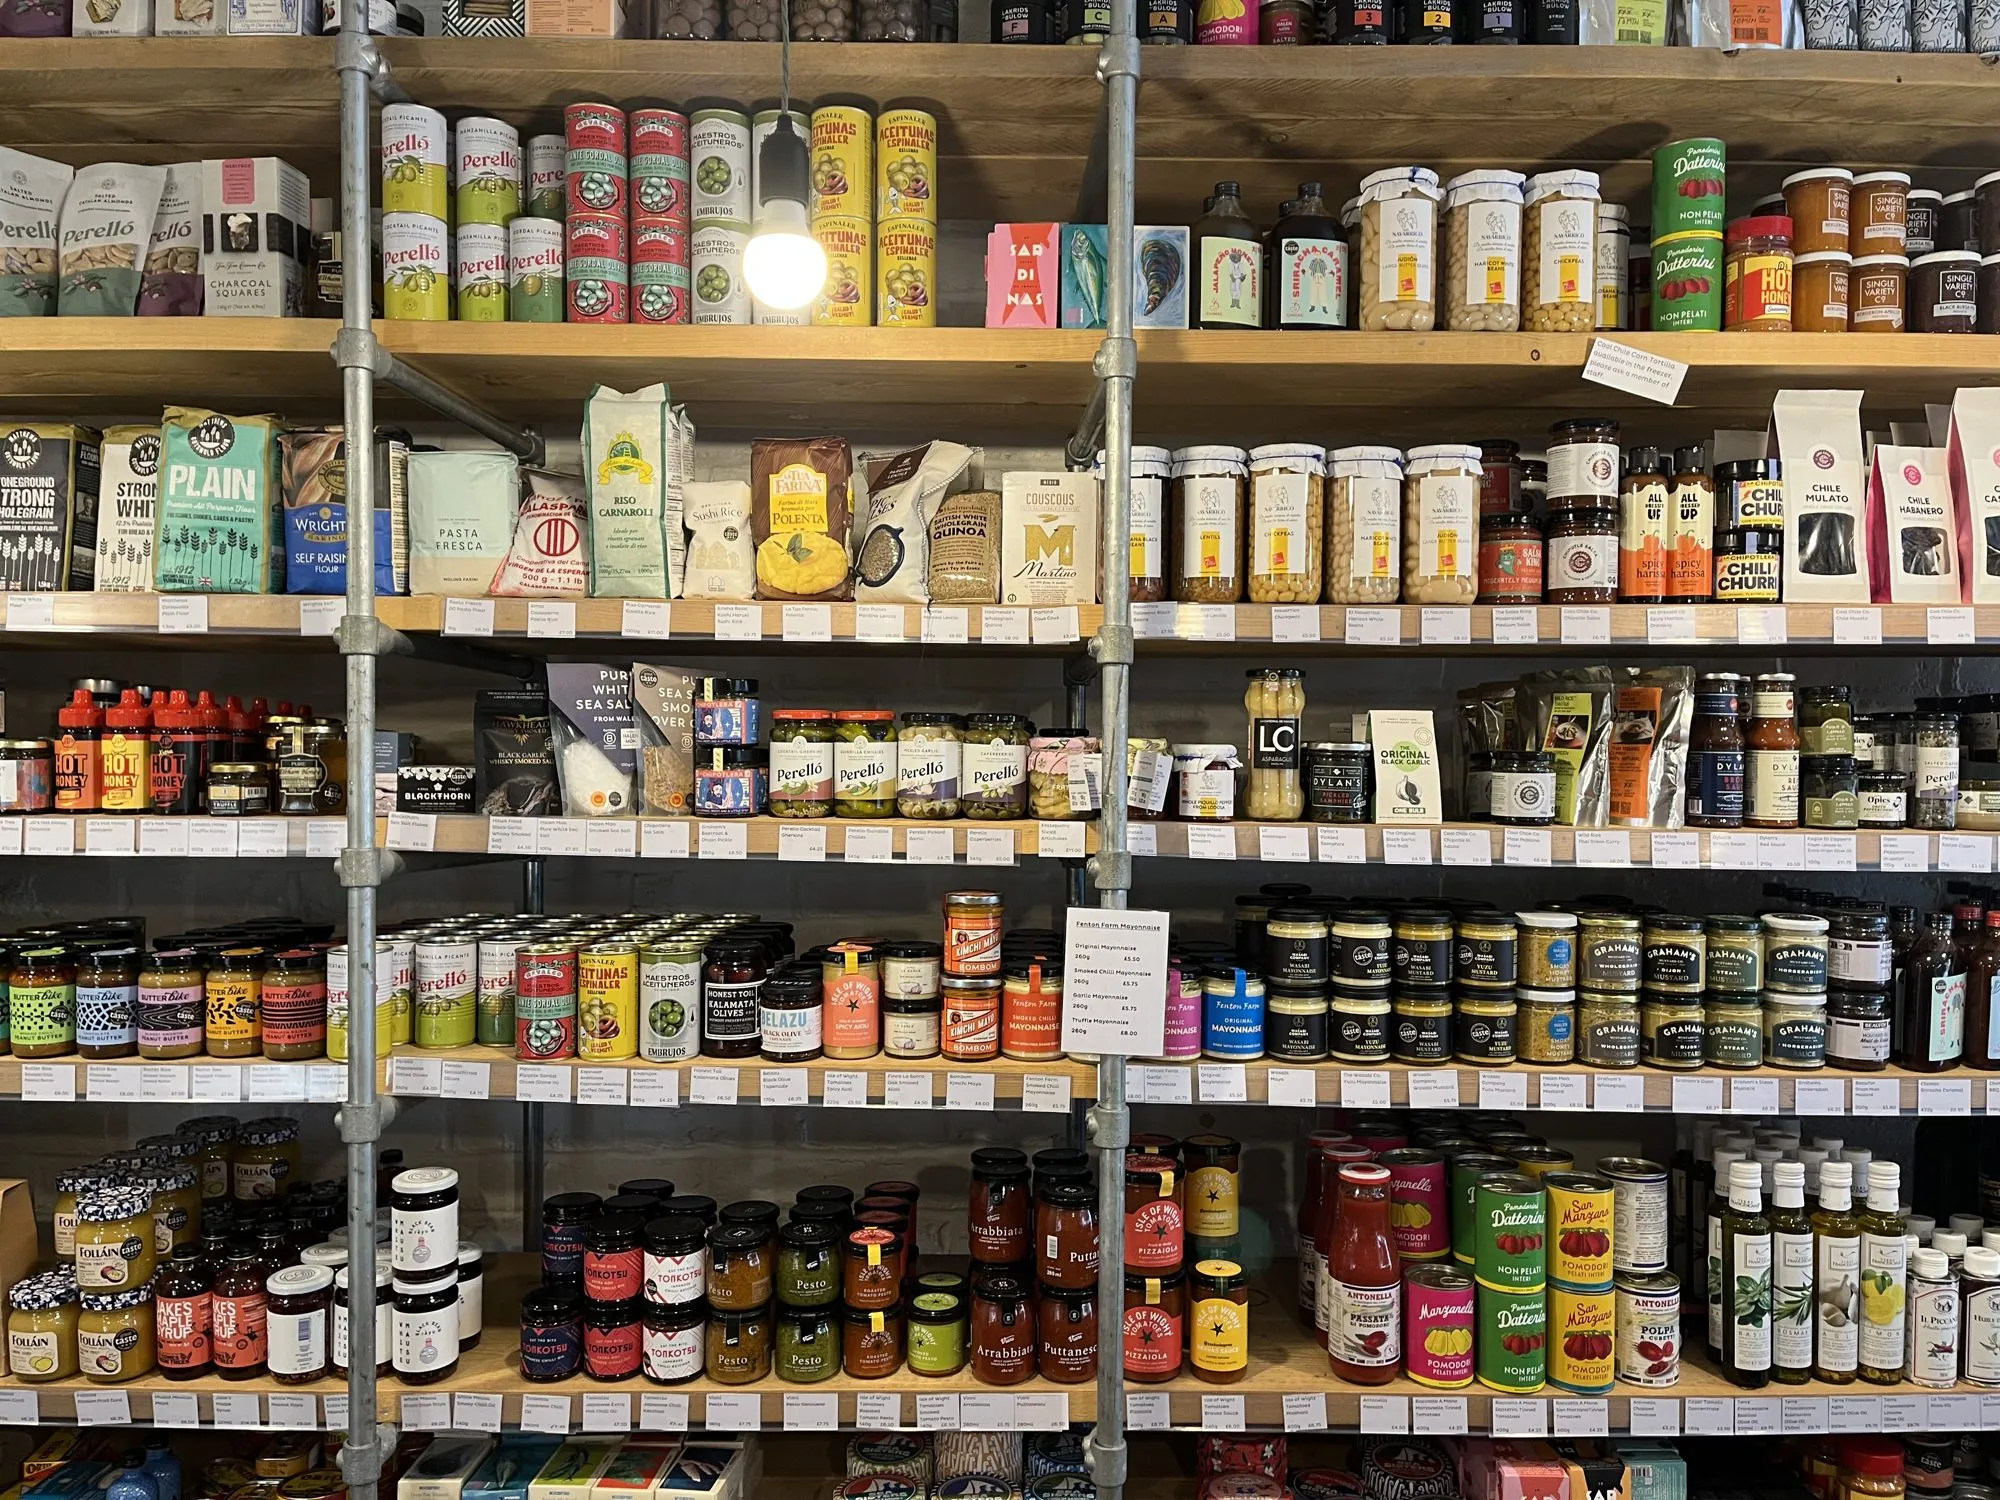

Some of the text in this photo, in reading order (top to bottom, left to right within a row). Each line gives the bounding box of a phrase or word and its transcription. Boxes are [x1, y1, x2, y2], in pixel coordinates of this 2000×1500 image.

[888, 115, 926, 125] ESPINALER
[693, 132, 736, 140] MAESTROS
[879, 128, 935, 142] ACEITUNAS
[887, 138, 930, 151] ESPINALER
[1673, 155, 1725, 178] Datterini
[696, 206, 733, 217] EMBRUJOS
[1010, 244, 1043, 257] SAR
[1292, 245, 1342, 300] SRIRACHA CARAMEL
[1656, 256, 1715, 280] Datterini
[1018, 269, 1034, 281] DI
[1761, 268, 1792, 291] HOT
[1946, 274, 1973, 284] SINGLE
[210, 279, 272, 290] CHARCOAL
[1945, 282, 1973, 292] VARIETY
[216, 288, 266, 298] SQUARES
[1007, 293, 1042, 305] NAS
[1660, 310, 1707, 322] NON PELATI
[1593, 350, 1624, 365] available
[1597, 340, 1676, 370] Cool Chile Corn Tortilla
[1589, 360, 1612, 370] please
[1631, 373, 1660, 385] member
[168, 464, 256, 501] PLAIN
[776, 480, 822, 493] FARINA
[1812, 484, 1841, 492] CHILE
[614, 496, 636, 504] RISO
[1026, 494, 1075, 505] COUSCOUS
[1681, 494, 1698, 503] ALL
[1806, 494, 1849, 503] MULATO
[599, 508, 653, 517] CARNAROLI
[693, 508, 744, 523] Sushi Rice
[1680, 508, 1698, 520] UP
[1900, 506, 1944, 515] HABANERO
[772, 513, 824, 525] POLENTA
[934, 514, 987, 525] BRITISH WHITE
[935, 520, 986, 530] WHOLEGRAIN
[439, 528, 478, 539] PASTA
[933, 527, 986, 540] QUINOA
[436, 541, 483, 552] FRESCA
[295, 553, 314, 564] SELF
[174, 566, 195, 574] 1912
[314, 565, 338, 574] FLOUR
[1013, 561, 1077, 579] Martino
[1675, 559, 1702, 571] spicy
[1726, 563, 1771, 576] CHILI
[522, 572, 539, 581] 500
[1670, 568, 1706, 578] harissa
[1718, 577, 1776, 590] CHURRI
[576, 700, 604, 710] SEA
[1259, 725, 1295, 753] LC
[1380, 750, 1430, 760] ORIGINAL
[104, 754, 138, 774] HOT
[777, 762, 823, 782] Perelló
[840, 762, 885, 782] Perelló
[900, 761, 944, 781] Perelló
[974, 764, 1019, 784] Perelló
[104, 776, 138, 788] HONEY
[1313, 777, 1361, 788] DYLAN'S
[1120, 923, 1160, 932] Mayonnaise
[1100, 944, 1136, 952] Mayonnaise
[1648, 948, 1697, 962] GRAHAM'S
[1776, 949, 1824, 962] GRAHAM'S
[1654, 974, 1689, 982] MUSTARD
[13, 989, 62, 1002] BUTTER bike
[708, 990, 737, 998] HONEST
[709, 1000, 754, 1009] KALAMATA
[1216, 1001, 1261, 1010] Fenton Farm
[713, 1009, 744, 1017] OLIVES
[761, 1012, 807, 1028] BELAZU
[950, 1013, 995, 1038] KIMCHI MAYO
[1093, 1018, 1129, 1026] Mayonnaise
[1009, 1022, 1060, 1031] MAYONNAISE
[1212, 1024, 1262, 1034] MAYONNAISE
[1708, 1024, 1758, 1038] GRAHAM'S
[648, 1047, 686, 1057] EMBRUJOS
[952, 1043, 992, 1052] BOMBOM
[1572, 1200, 1592, 1212] San
[1134, 1204, 1181, 1232] ISLE OF WIGHT
[1492, 1210, 1545, 1227] Datterini
[1560, 1209, 1609, 1225] Marzano
[79, 1247, 118, 1258] FOLLÁIN
[1138, 1245, 1178, 1254] PIZZAIOLA
[1498, 1266, 1541, 1276] NON PELATI
[796, 1278, 826, 1291] Pesto
[1348, 1291, 1392, 1300] ANTONELLA
[1350, 1313, 1389, 1323] PASSATA
[1642, 1326, 1674, 1335] POLPA
[12, 1334, 49, 1347] FOLLÁIN
[652, 1346, 696, 1358] TONKOTSU
[977, 1344, 1034, 1357] Arrabbiata
[718, 1354, 748, 1366] Pesto
[792, 1354, 822, 1366] Pesto
